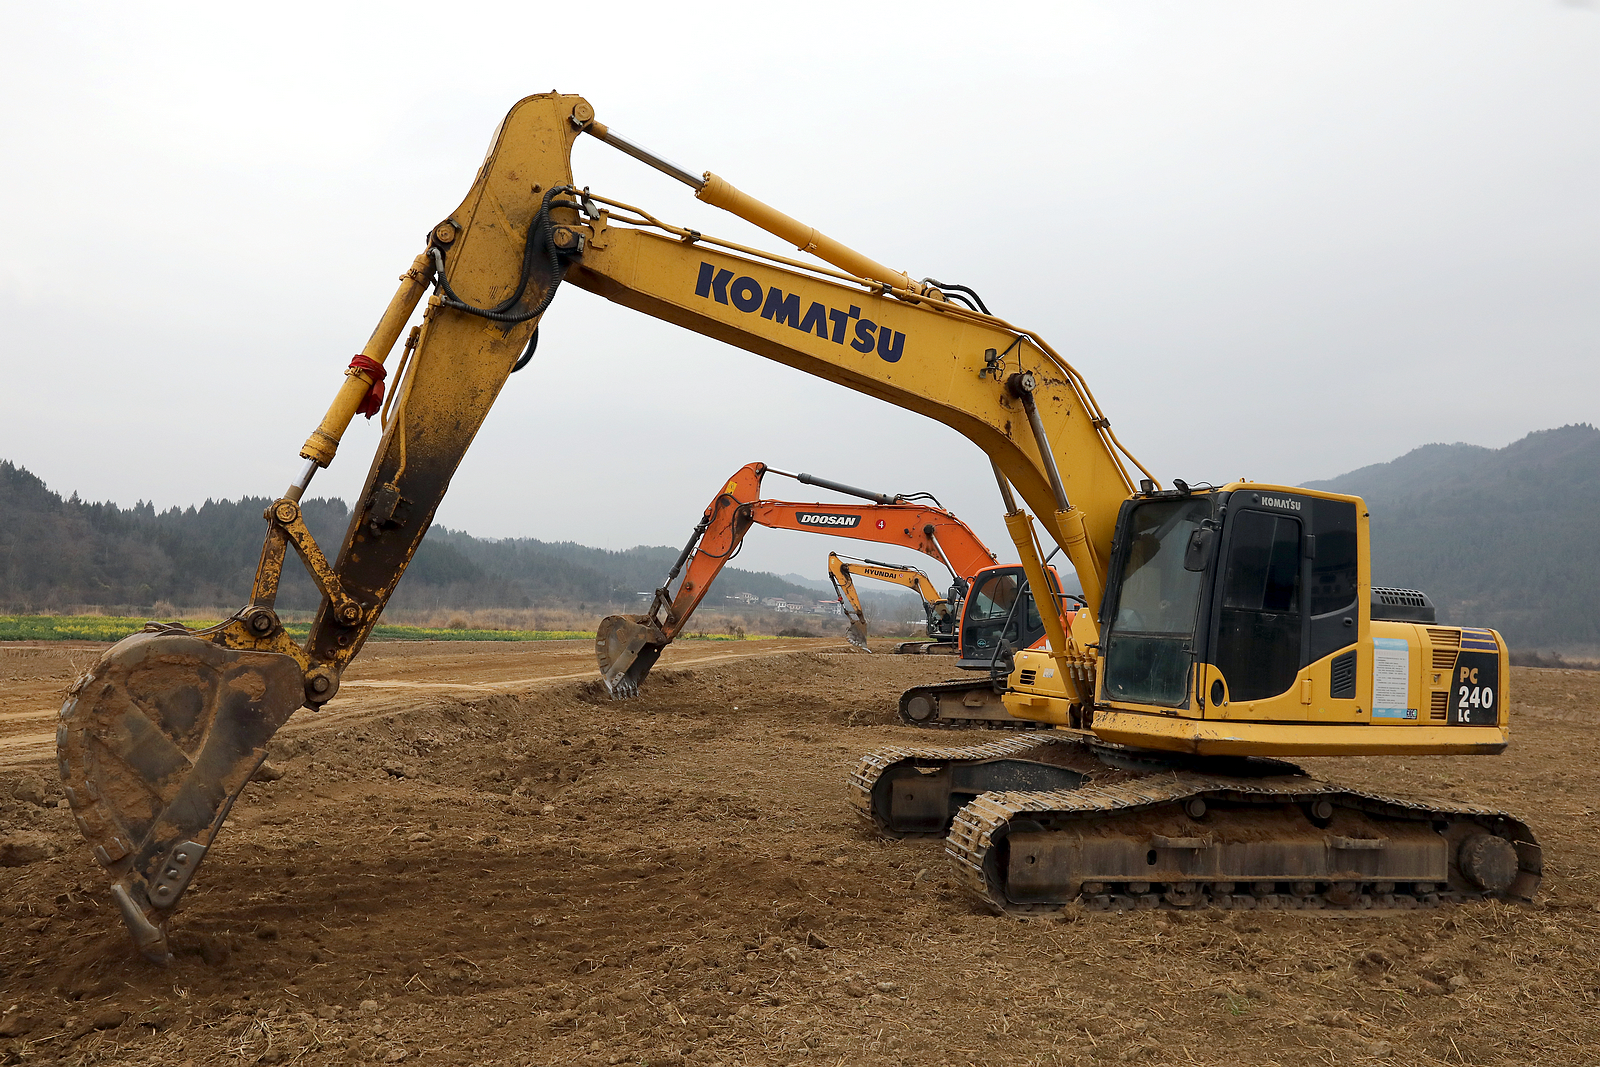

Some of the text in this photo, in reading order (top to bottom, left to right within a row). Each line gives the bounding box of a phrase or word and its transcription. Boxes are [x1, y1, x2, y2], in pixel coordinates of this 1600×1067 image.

[695, 261, 906, 363] KOMATSU
[1261, 497, 1301, 510] KOMATSU
[801, 514, 856, 526] DOOSAN
[878, 520, 885, 528] 4
[864, 568, 897, 579] HYUNDAI
[1459, 666, 1478, 684] PC
[1458, 685, 1493, 708] 240
[1458, 709, 1470, 722] LC
